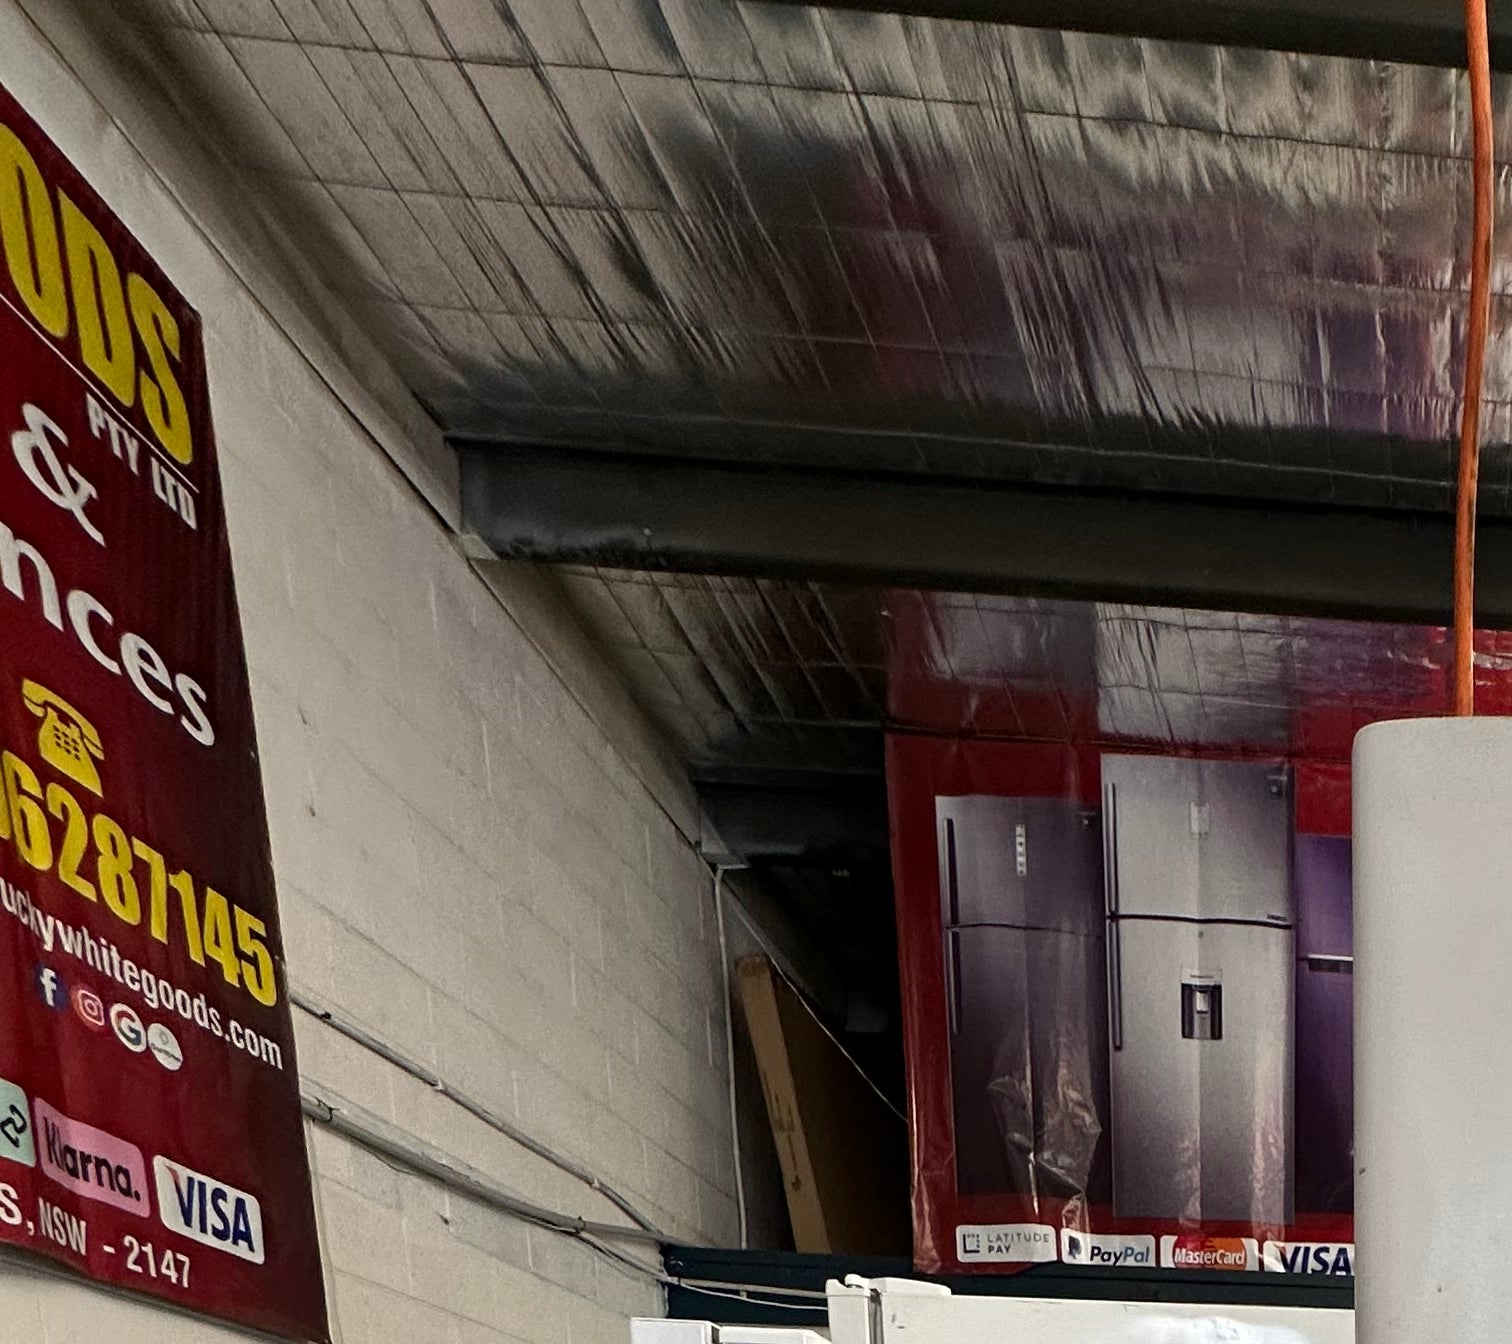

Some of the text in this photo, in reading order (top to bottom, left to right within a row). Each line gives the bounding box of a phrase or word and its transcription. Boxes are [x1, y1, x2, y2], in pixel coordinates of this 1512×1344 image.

[11, 402, 106, 548] &
[86, 391, 197, 531] PTY LTD
[0, 748, 277, 1007] 6287145
[167, 1164, 256, 1254] VISA
[987, 1232, 1049, 1244] LATITUDE
[38, 1196, 87, 1256] NSW
[123, 1234, 191, 1289] 2147
[987, 1244, 1011, 1255] PAY
[1090, 1245, 1150, 1266] PayPal
[1174, 1247, 1246, 1266] MasterCard
[1279, 1245, 1354, 1276] VISA
